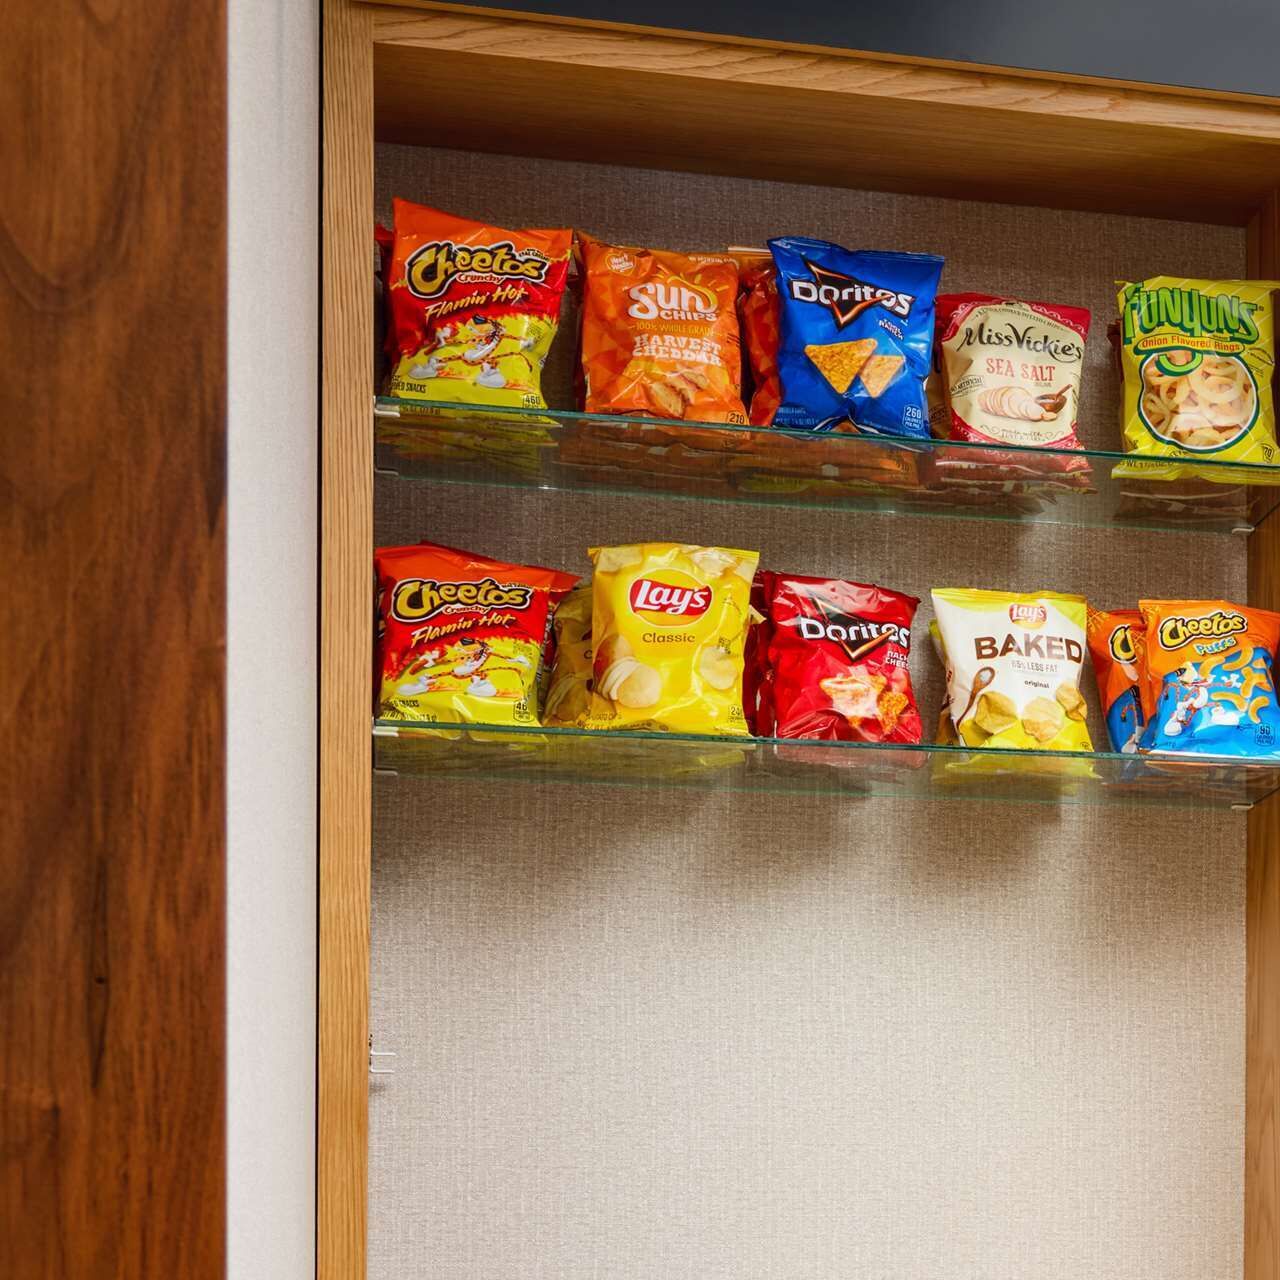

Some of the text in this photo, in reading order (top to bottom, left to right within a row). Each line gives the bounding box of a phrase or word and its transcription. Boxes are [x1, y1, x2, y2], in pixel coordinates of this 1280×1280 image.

[408, 240, 549, 297] Cheetos
[456, 273, 506, 285] Crunchy
[492, 284, 529, 304] Hot
[628, 283, 718, 320] Sun
[792, 280, 913, 316] Doritos
[659, 310, 717, 322] CHIPS
[1124, 283, 1259, 345] FUNYUNS
[634, 334, 721, 354] HARVEST
[956, 322, 1082, 363] Miss Vickie's
[1142, 336, 1240, 352] Onion Flavored Rings
[986, 358, 1056, 382] SEA SALT
[729, 412, 745, 424] 210
[905, 407, 921, 418] 260
[393, 577, 532, 621] Cheetos
[634, 581, 709, 615] Lay's
[478, 613, 516, 626] Hot
[1012, 605, 1045, 622] Lay's
[642, 632, 696, 643] Classic
[800, 617, 910, 648] Doritos
[1160, 612, 1246, 648] Cheetos
[974, 633, 1083, 664] BAKED
[1195, 636, 1236, 654] Puffs
[1027, 661, 1044, 671] LESS
[1024, 680, 1050, 689] original
